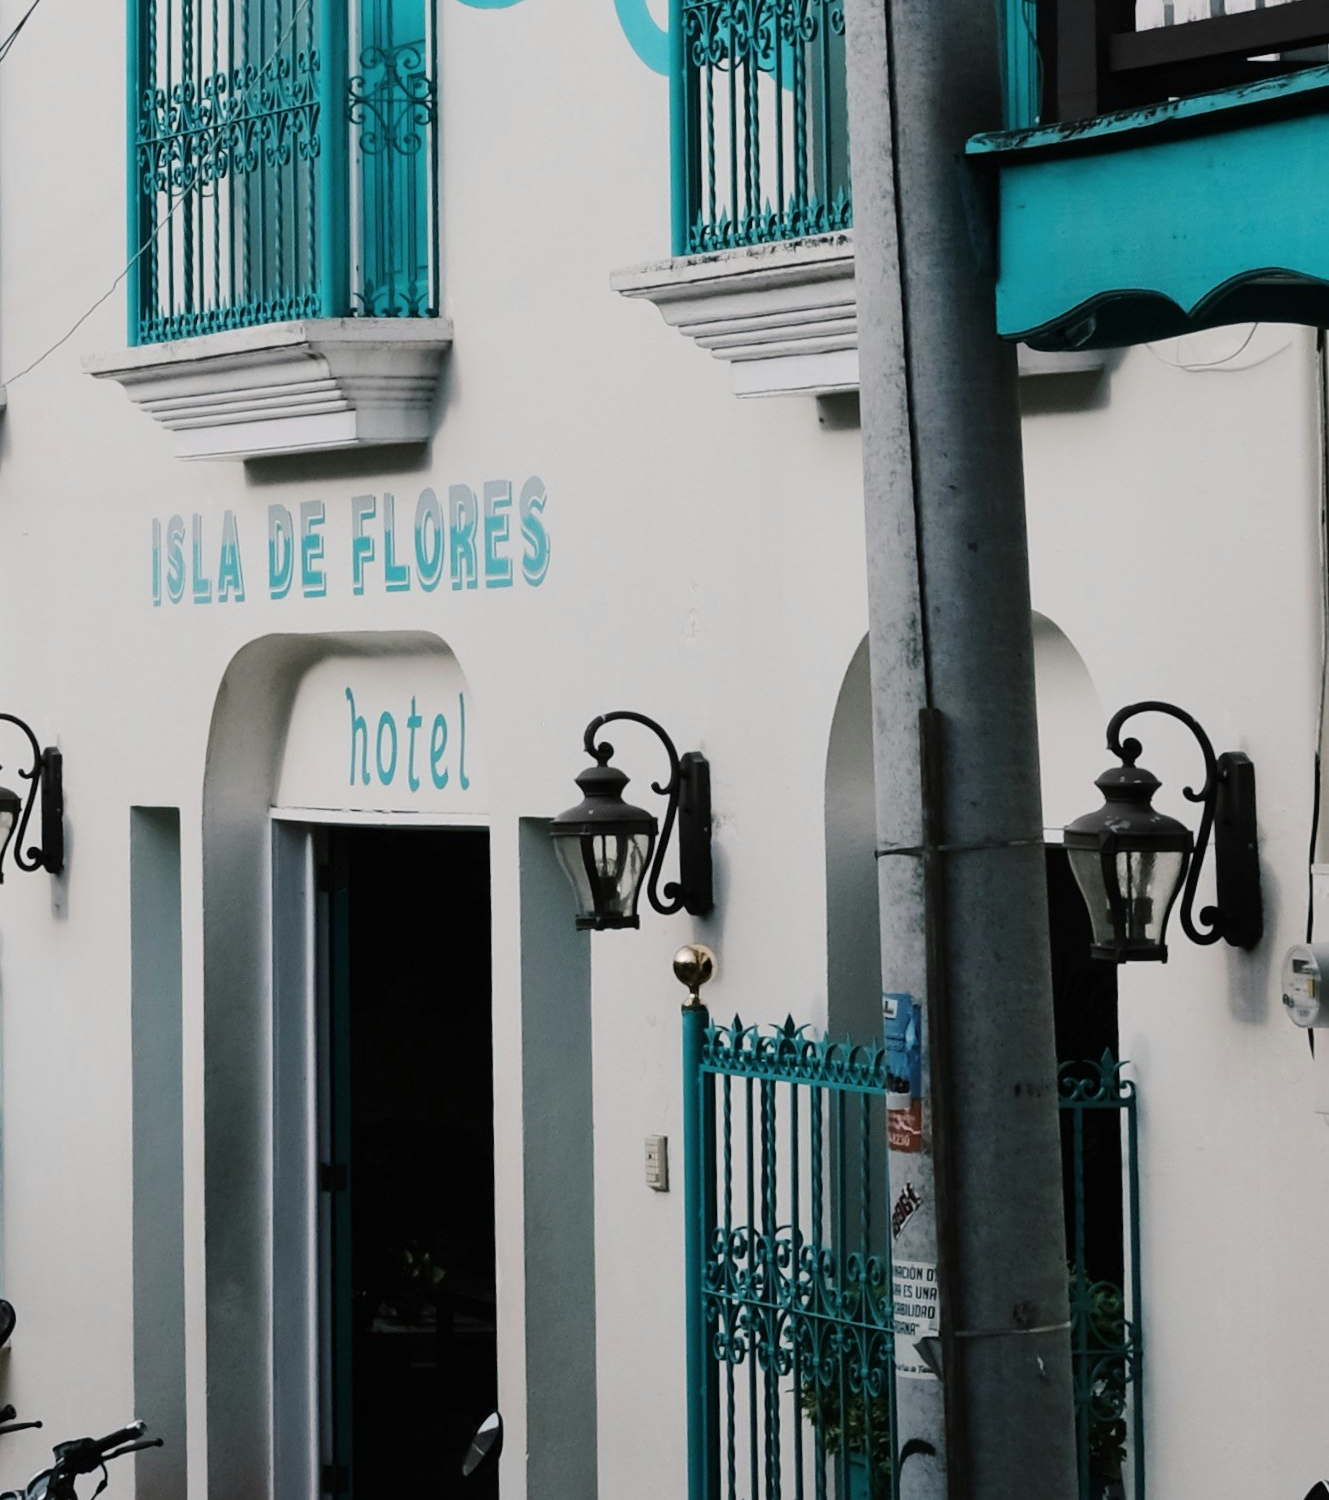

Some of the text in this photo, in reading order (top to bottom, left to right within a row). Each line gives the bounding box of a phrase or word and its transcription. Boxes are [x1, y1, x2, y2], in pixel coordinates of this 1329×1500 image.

[151, 475, 553, 607] ISLA DE FLORES
[344, 686, 470, 792] hotel
[903, 1285, 912, 1298] ES
[916, 1286, 938, 1301] UNA
